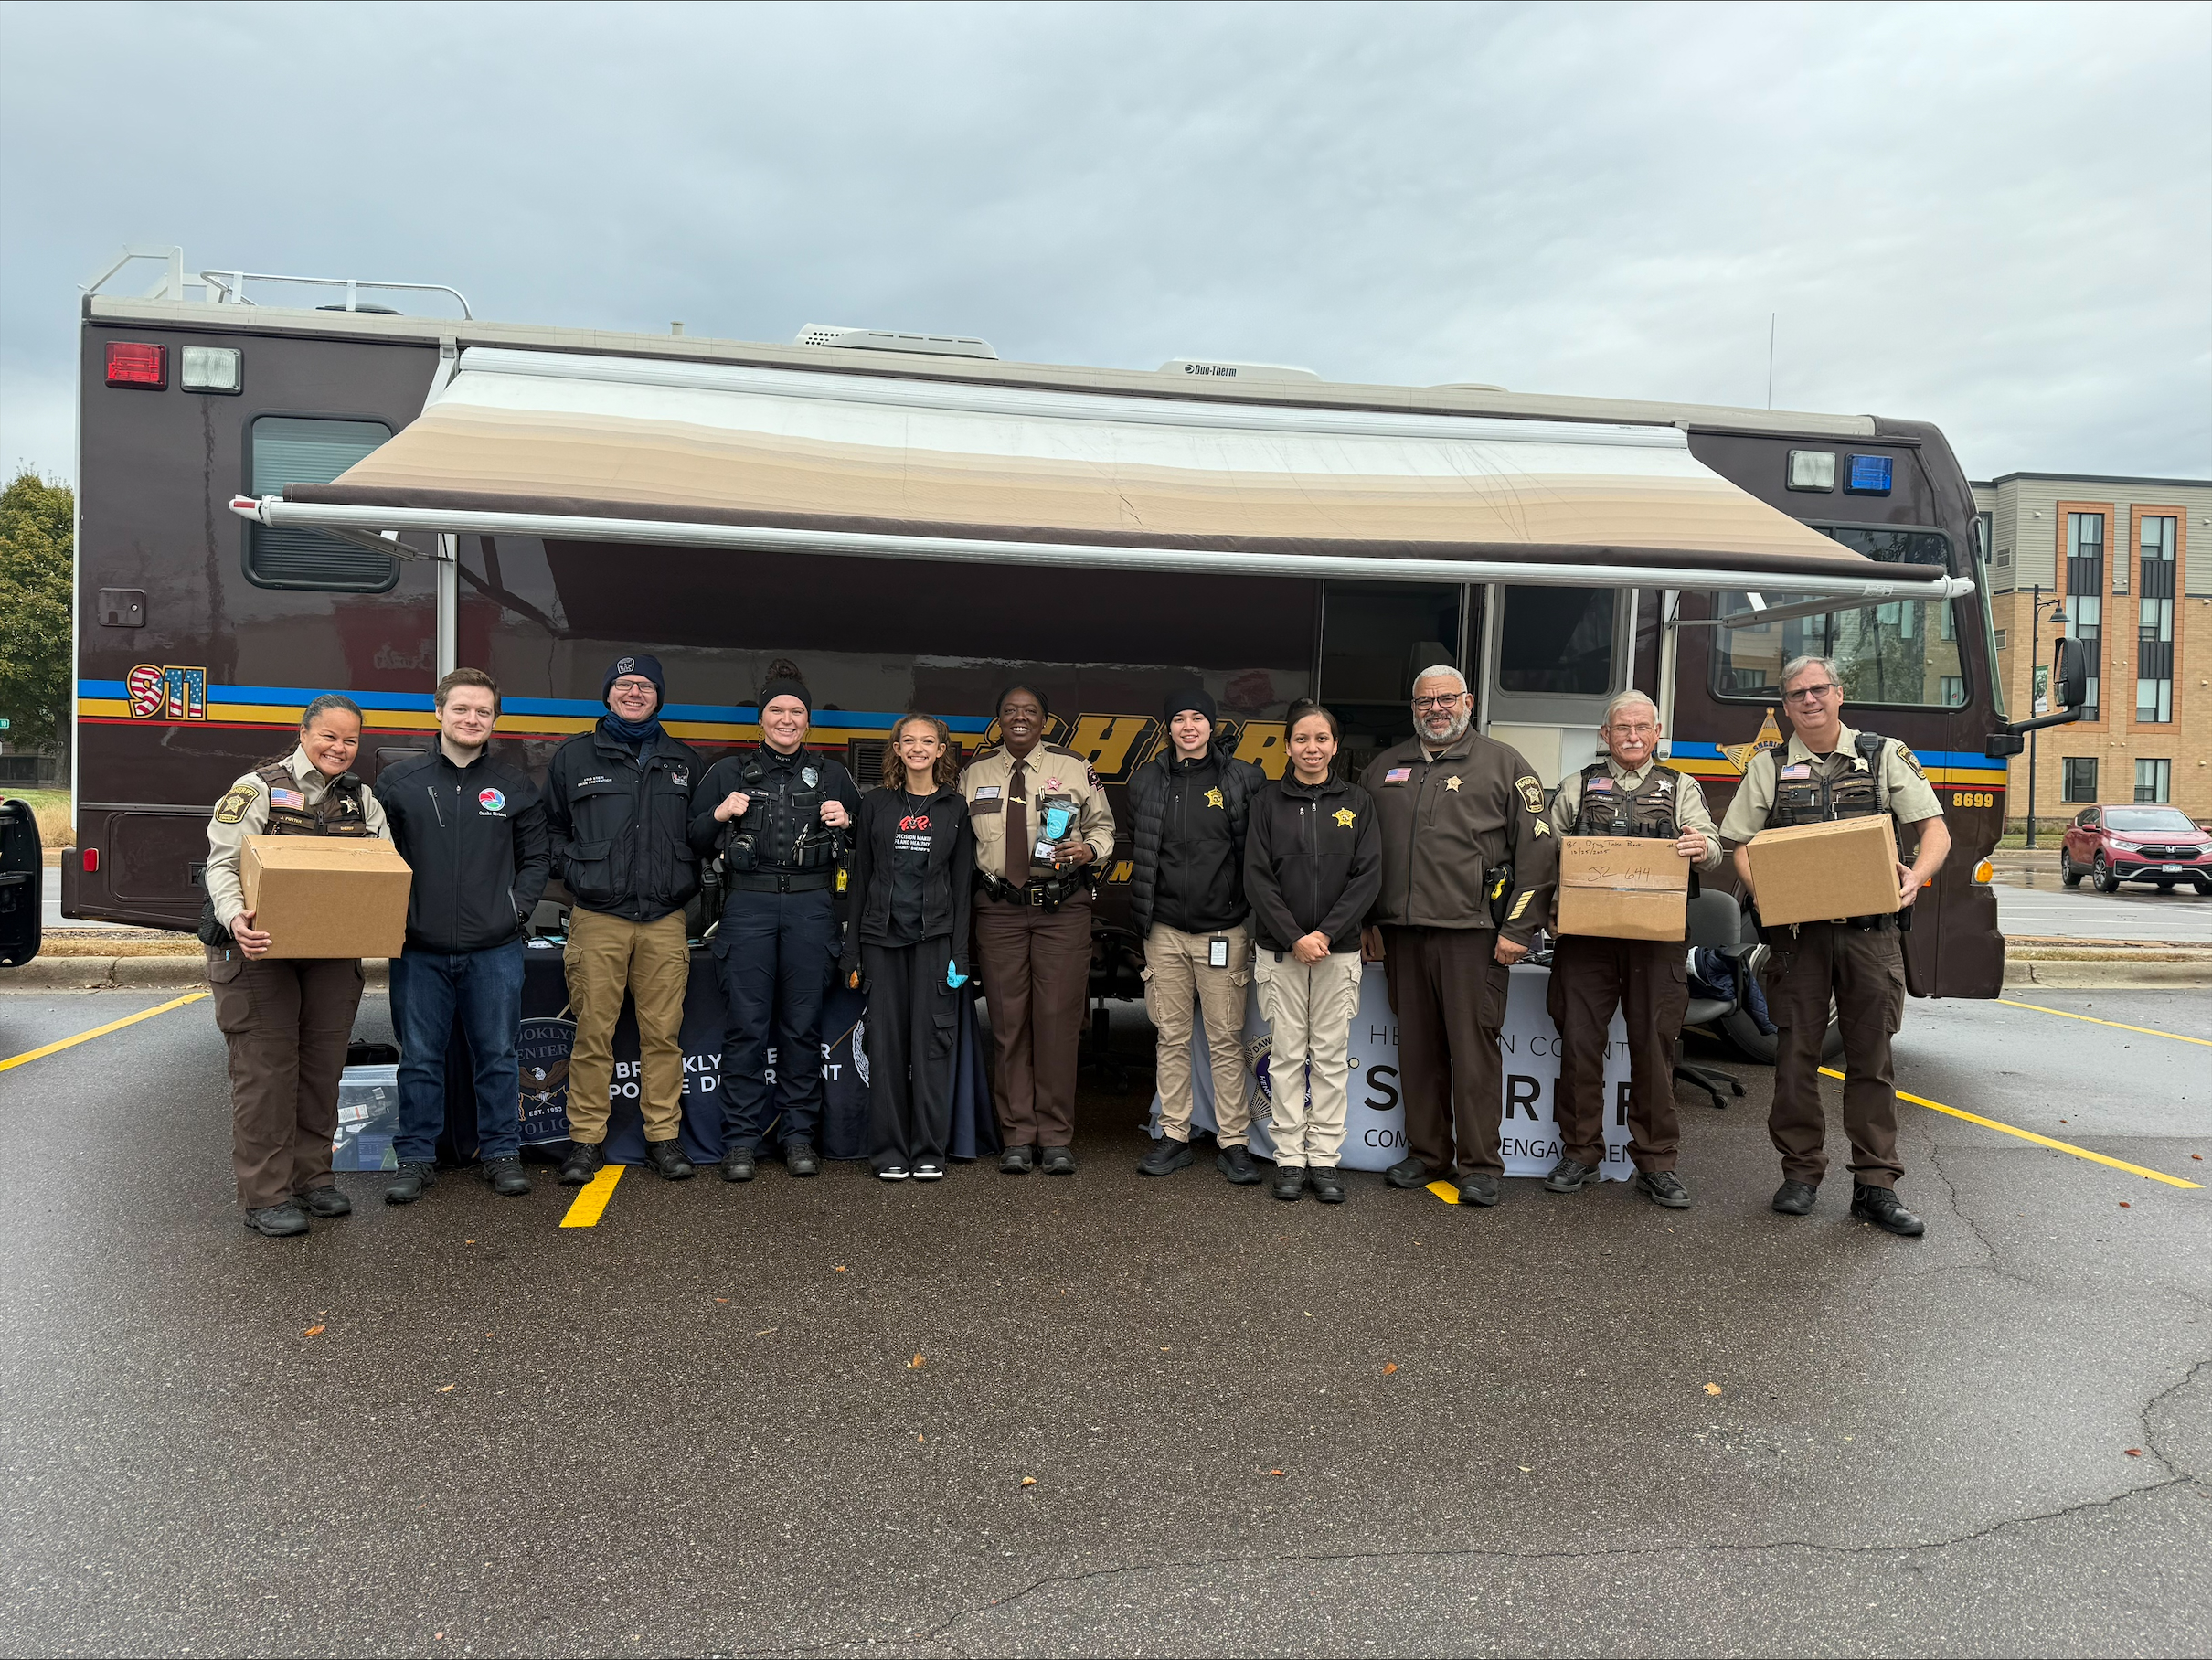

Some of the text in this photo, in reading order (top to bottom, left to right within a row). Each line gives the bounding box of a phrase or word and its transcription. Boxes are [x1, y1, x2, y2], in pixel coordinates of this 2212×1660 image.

[1194, 364, 1238, 378] Duo-Therm
[126, 663, 207, 721] 911
[1753, 740, 1782, 752] SHERI
[1952, 792, 1994, 808] 8699
[1624, 867, 1652, 882] 644
[516, 1043, 569, 1060] ENTER
[528, 1109, 545, 1117] EST.
